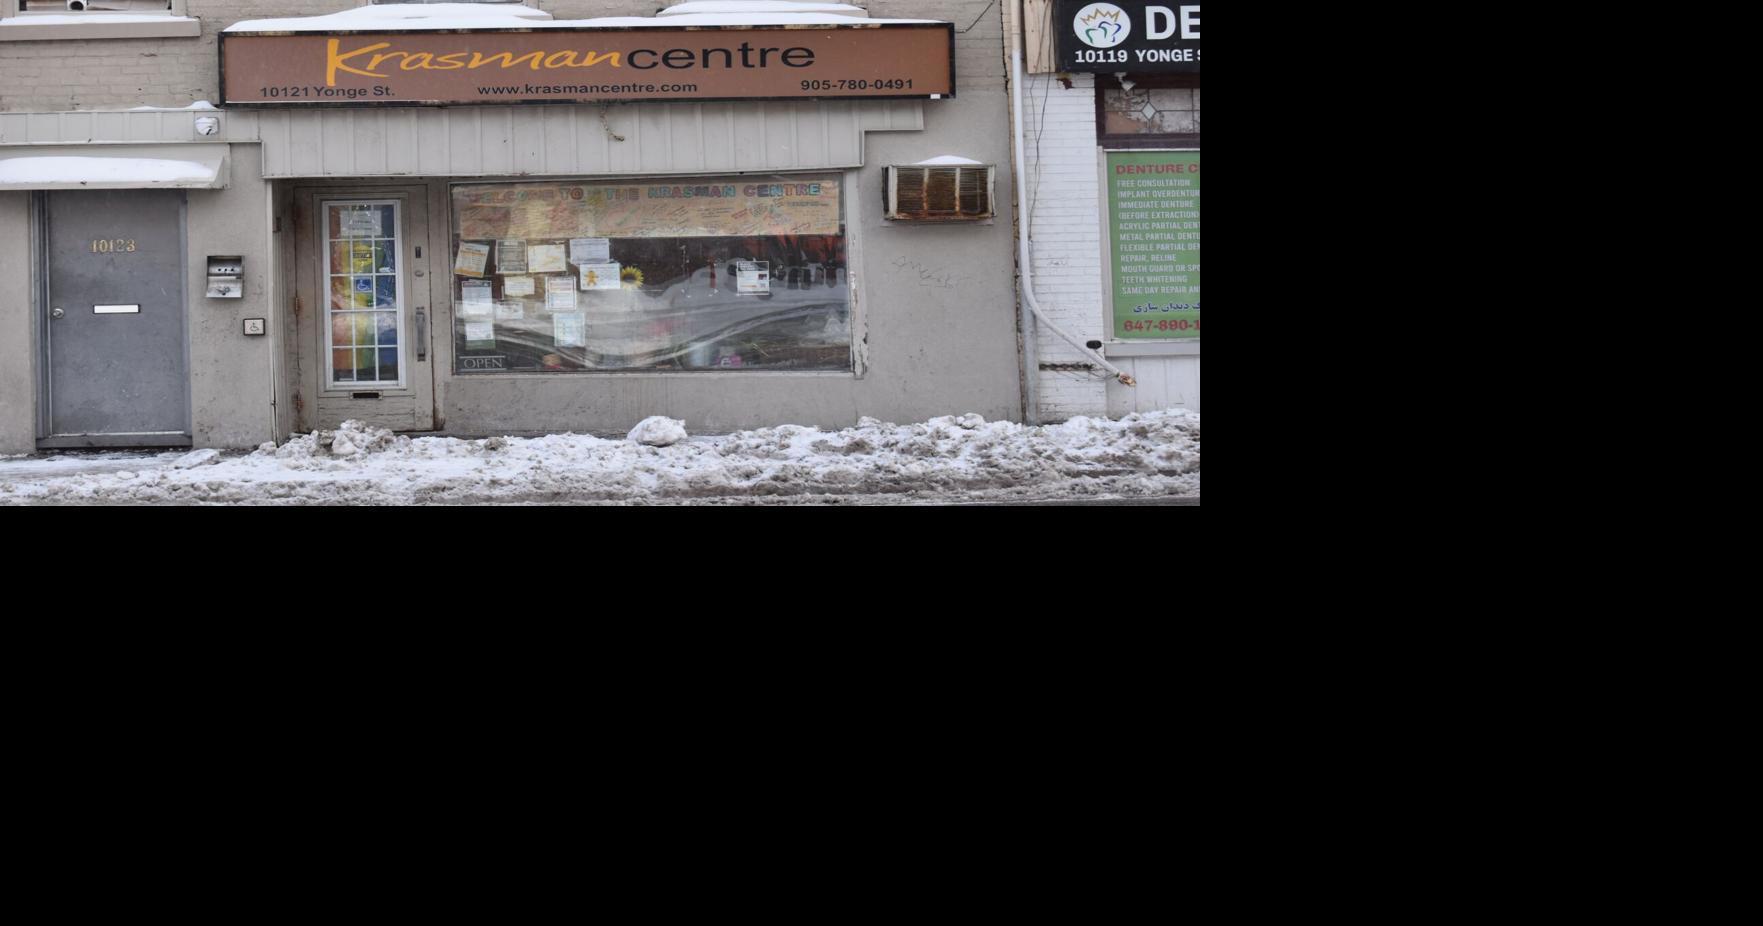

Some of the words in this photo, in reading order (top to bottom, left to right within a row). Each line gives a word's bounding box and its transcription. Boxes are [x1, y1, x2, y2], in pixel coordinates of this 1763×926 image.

[1075, 49, 1128, 63] 10119
[1135, 49, 1193, 62] YONGE
[477, 82, 698, 95] www.krasmancentre.com
[800, 78, 913, 91] 905-780-0491
[260, 86, 308, 98] 10121
[313, 86, 367, 99] Yonge
[373, 85, 395, 97] St.
[1115, 163, 1184, 175] DENTURE
[1117, 180, 1136, 188] FREE
[1137, 179, 1190, 187] CONSULTATION
[648, 184, 736, 198] KRASMAN
[743, 183, 821, 197] CENTRE
[1118, 190, 1149, 198] IMPLANT
[1118, 201, 1159, 209] IMMEDIATE
[1160, 200, 1193, 208] DENTURE
[1120, 222, 1150, 230] ACRYLIC
[1151, 222, 1181, 230] PARTIAL
[1120, 233, 1143, 241] METAL
[1145, 232, 1174, 240] PARTIAL
[92, 239, 135, 252] 10123
[1120, 244, 1153, 252] FLEXIBLE
[1155, 243, 1185, 251] PARTIAL
[1151, 254, 1176, 262] RELINE
[1121, 265, 1147, 273] MOUTH
[1149, 265, 1173, 273] GUARD
[1122, 276, 1145, 284] TEETH
[1146, 275, 1188, 283] WHITENING
[1121, 286, 1142, 294] SAME
[464, 358, 502, 368] OPEN
